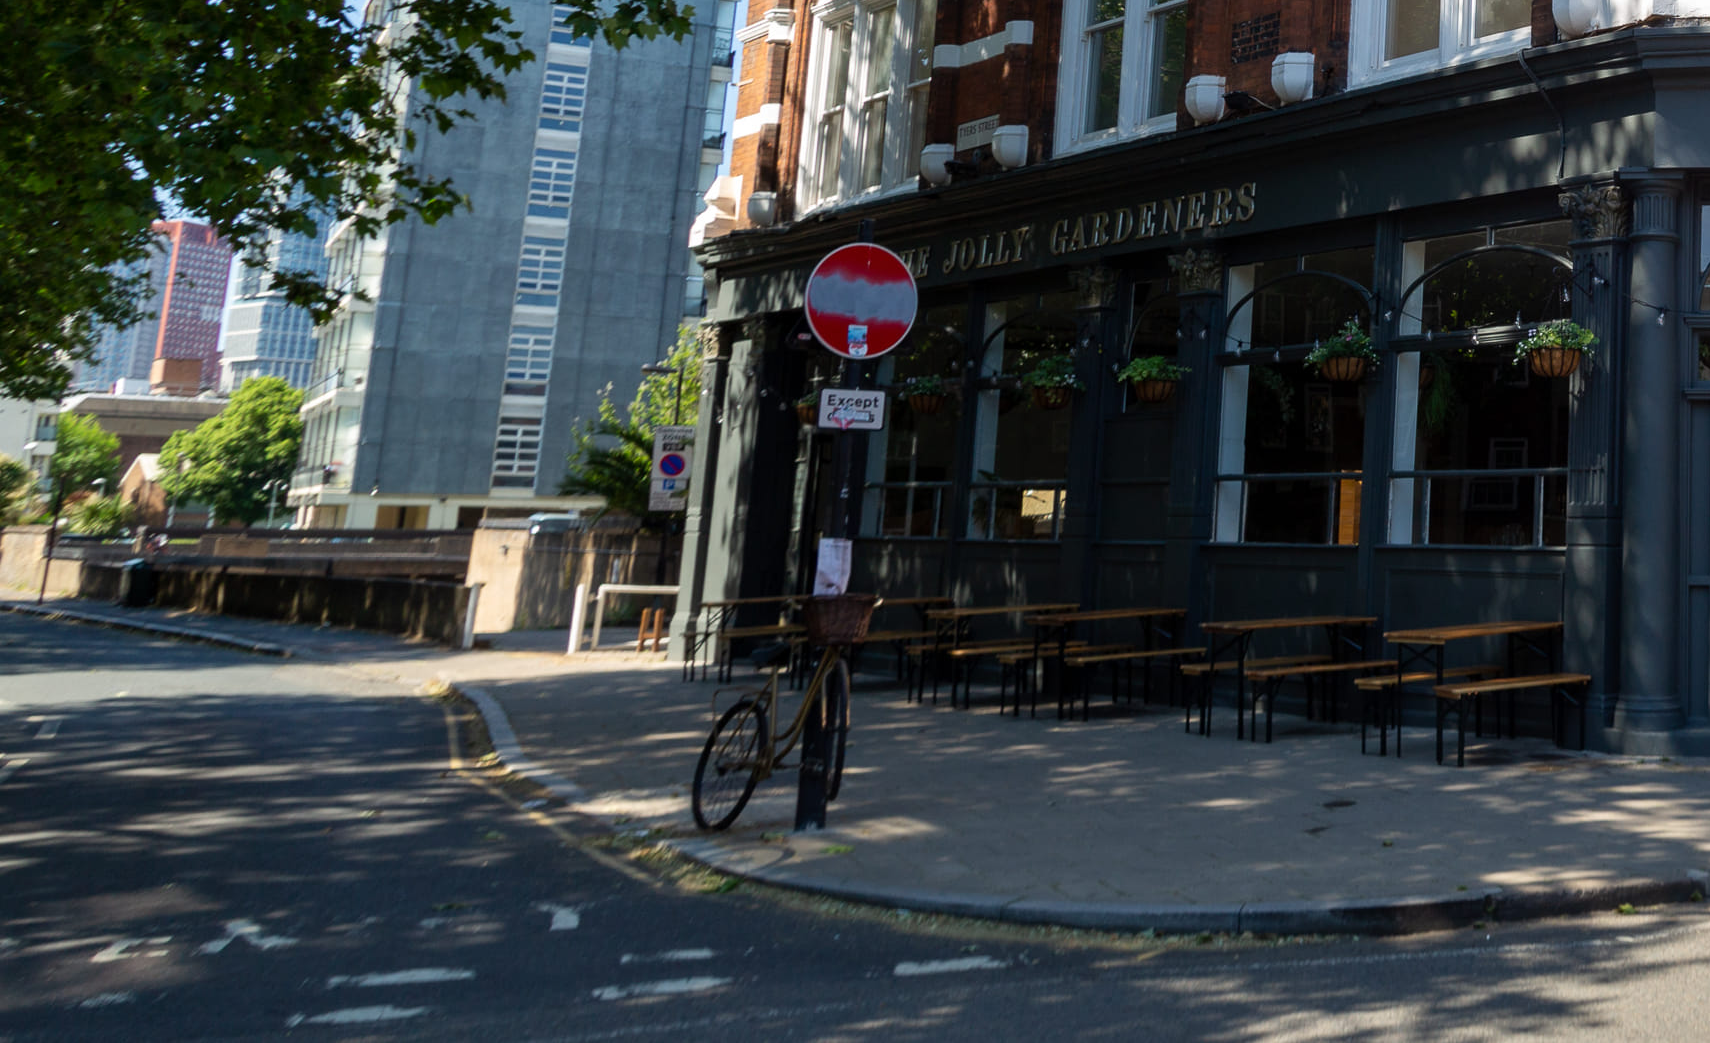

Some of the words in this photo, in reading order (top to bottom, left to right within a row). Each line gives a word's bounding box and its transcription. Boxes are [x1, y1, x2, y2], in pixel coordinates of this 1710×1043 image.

[901, 245, 931, 279] HE
[942, 225, 1031, 275] JOLLY
[1049, 181, 1257, 255] GARDENERS
[827, 394, 879, 409] Except
